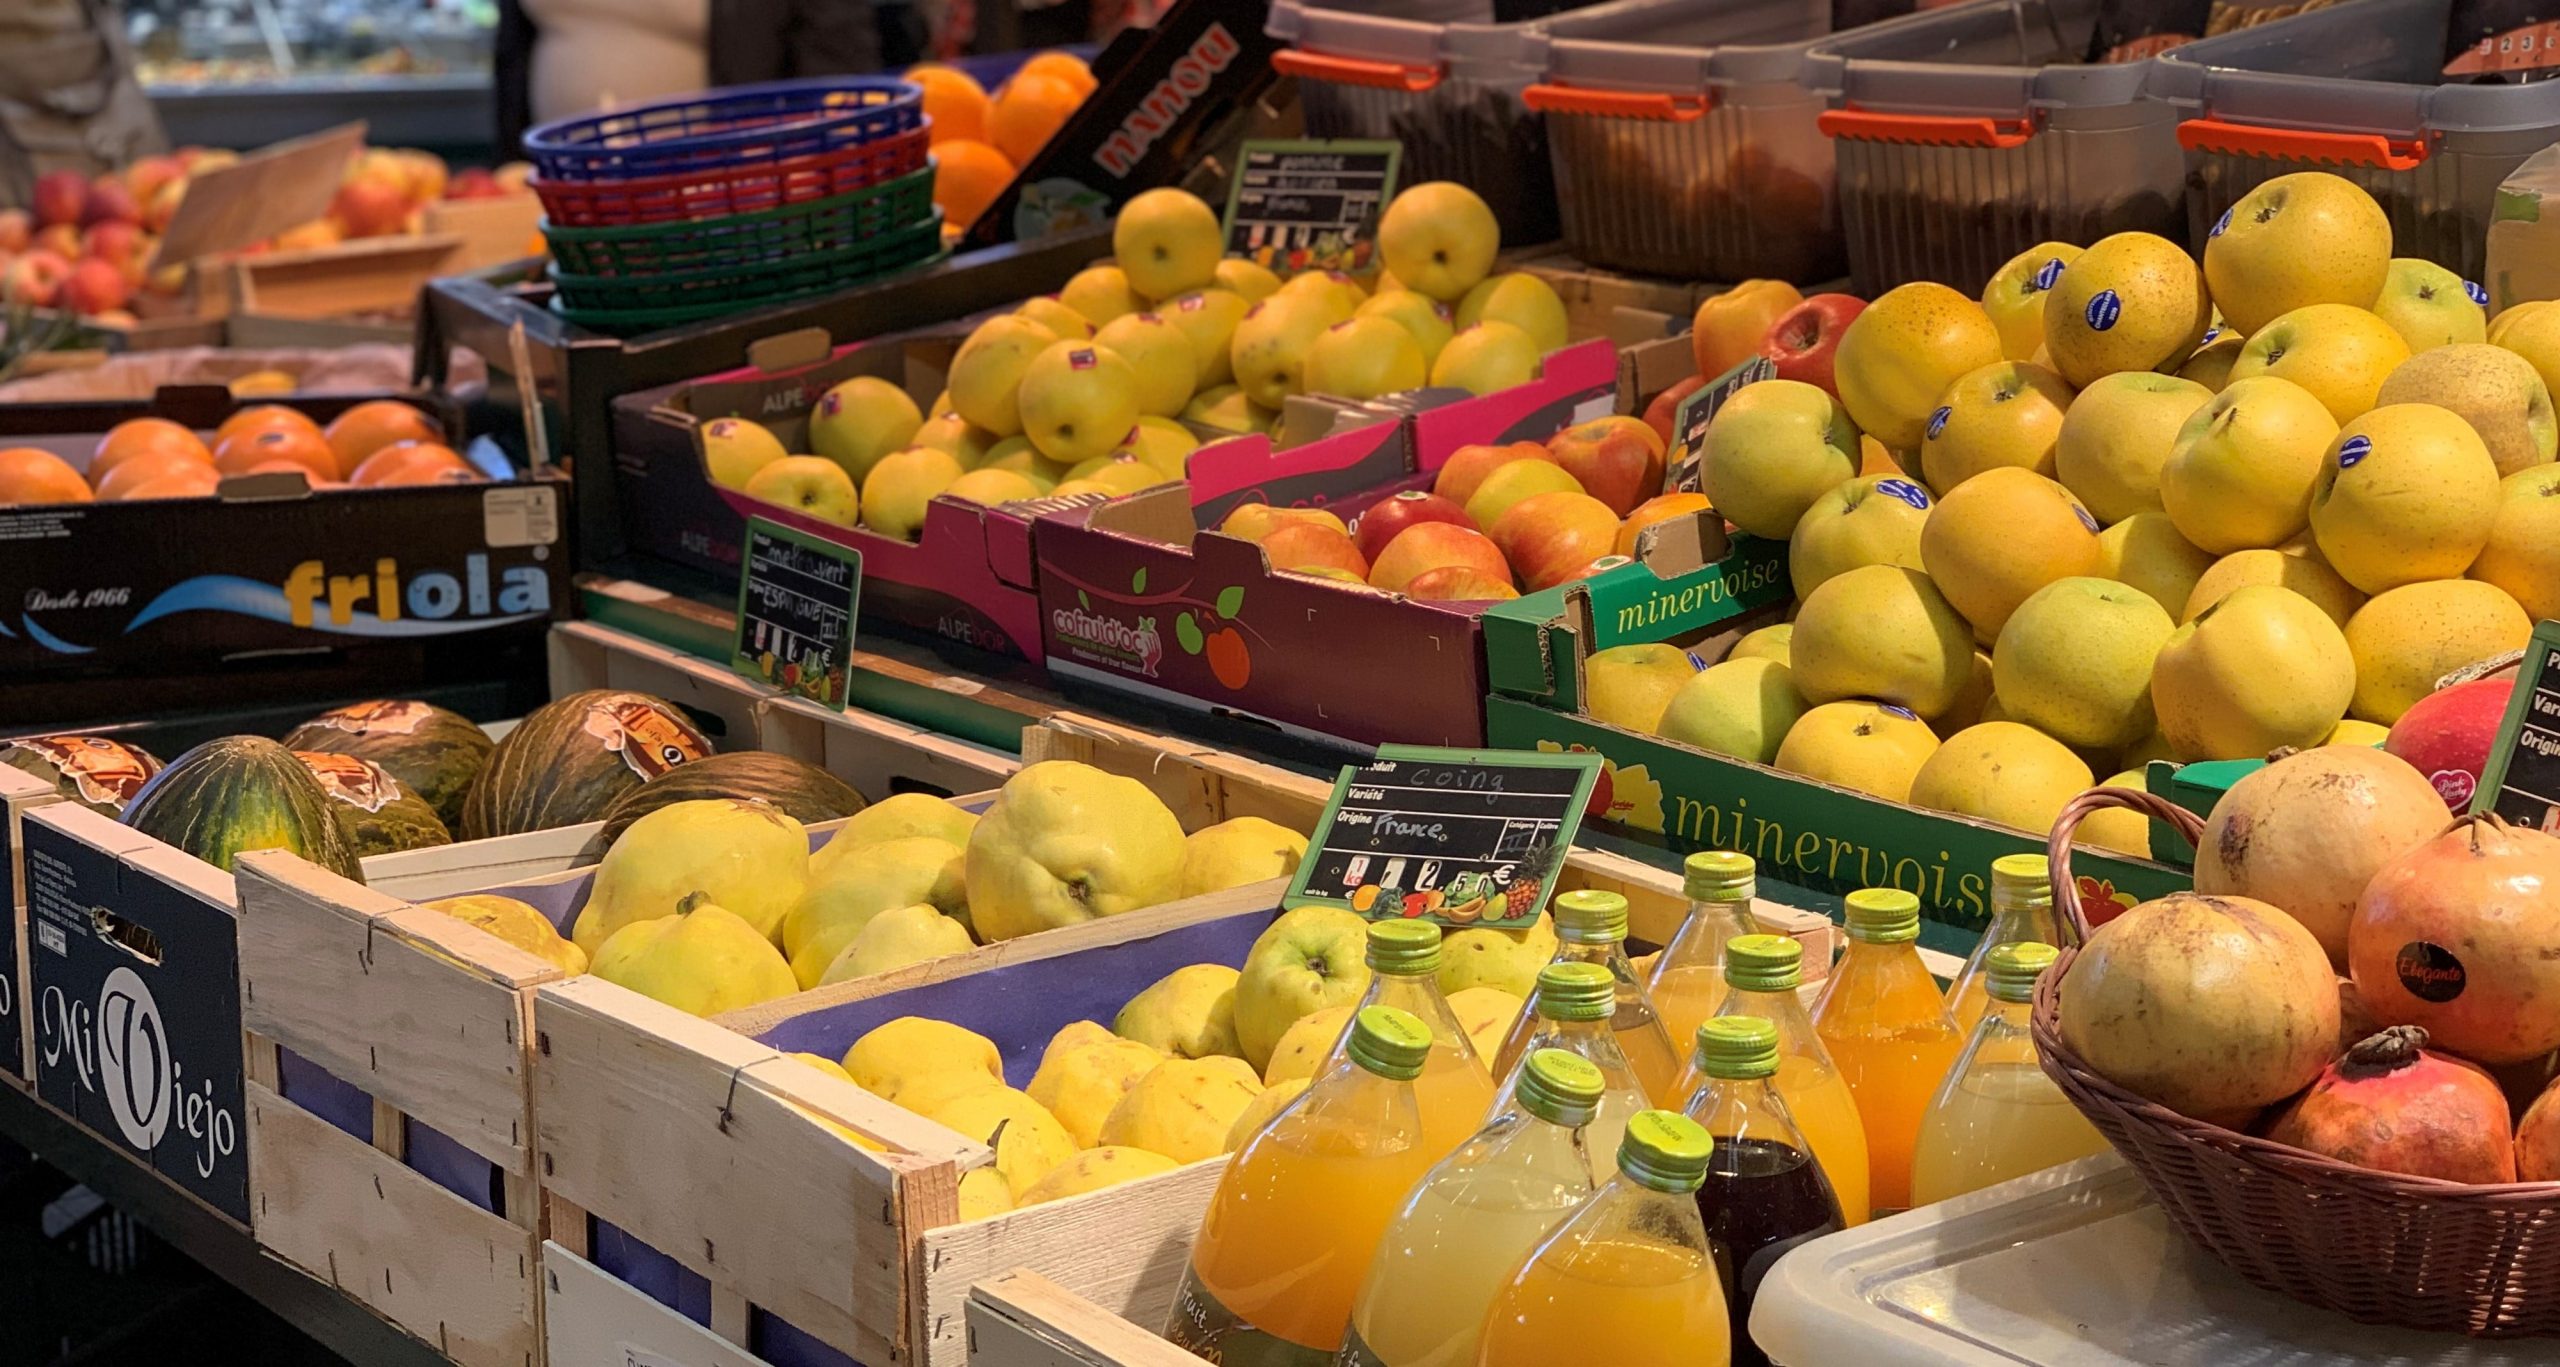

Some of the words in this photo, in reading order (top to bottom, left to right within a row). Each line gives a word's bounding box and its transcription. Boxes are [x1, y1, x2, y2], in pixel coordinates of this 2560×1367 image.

[83, 586, 131, 609] 1966
[283, 553, 551, 628] friola
[1618, 559, 1778, 634] minervoise
[1348, 787, 1386, 801] Variété
[1410, 768, 1504, 806] coing
[2438, 775, 2465, 792] Pink
[1337, 810, 1373, 825] Origine
[1372, 810, 1443, 839] France
[1675, 795, 1986, 918] minervois
[1493, 864, 1516, 885] €
[43, 986, 95, 1093] Mi
